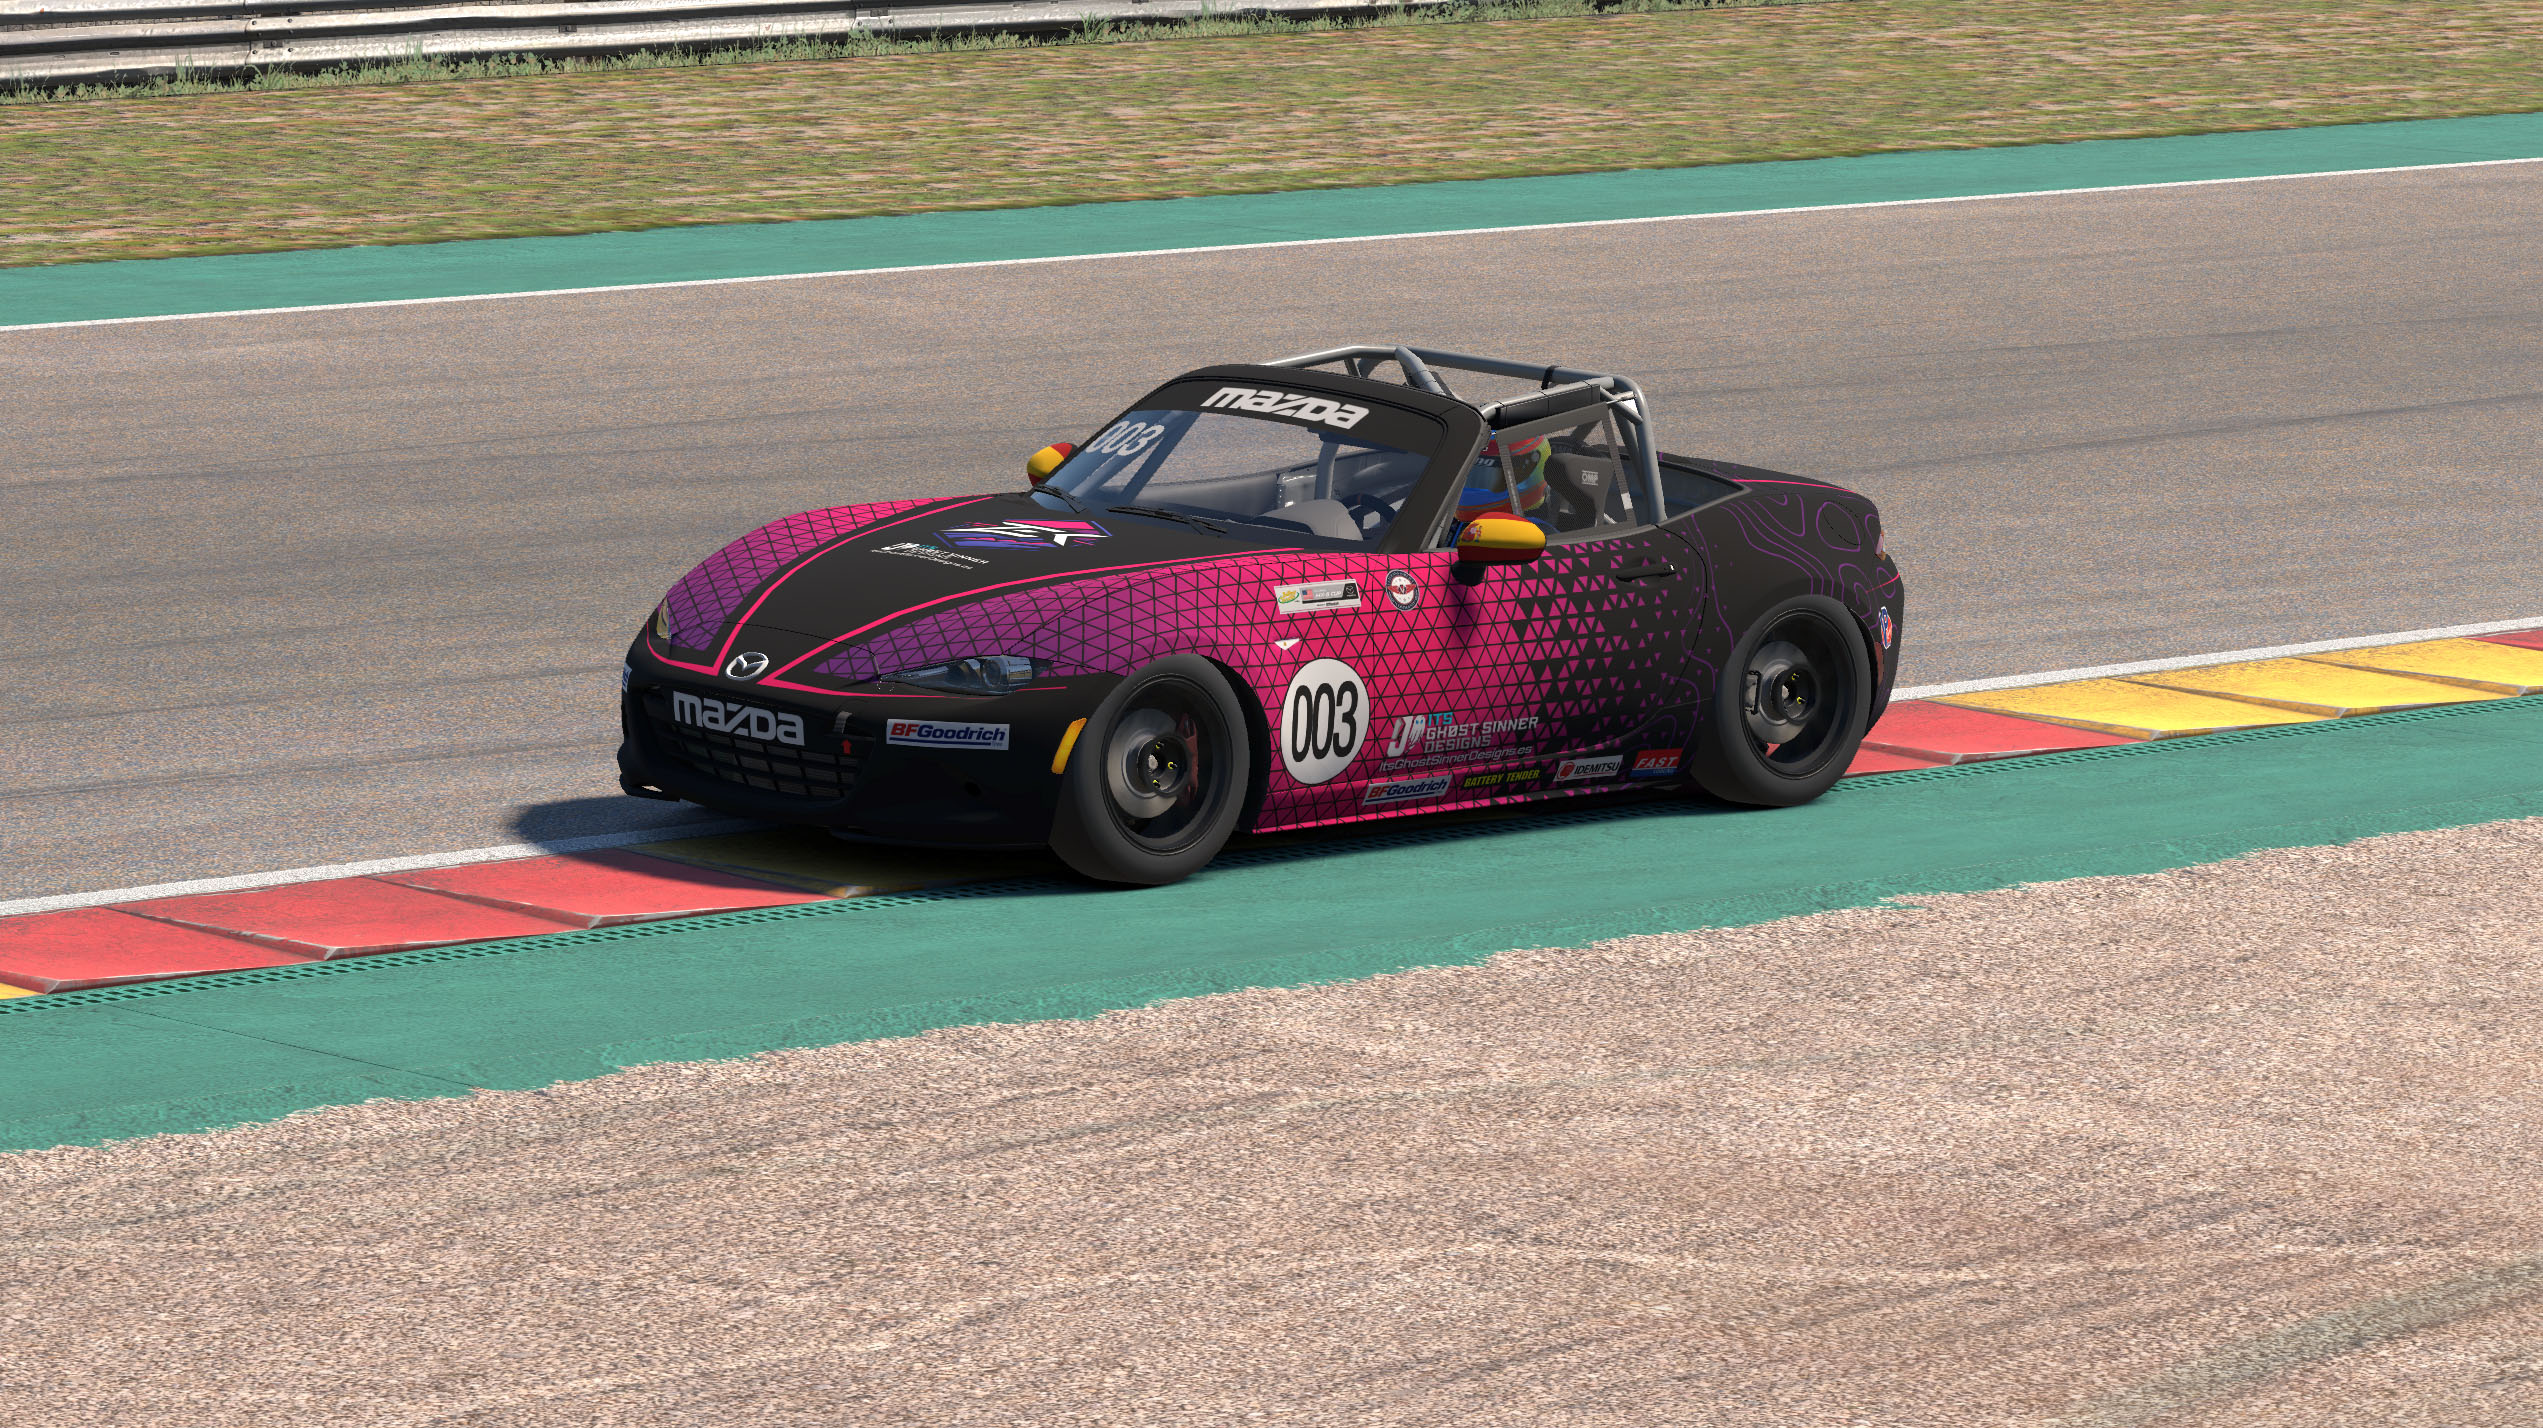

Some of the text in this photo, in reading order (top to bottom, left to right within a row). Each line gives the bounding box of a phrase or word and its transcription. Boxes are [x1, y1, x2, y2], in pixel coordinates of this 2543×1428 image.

[1085, 420, 1165, 456] 003
[1292, 681, 1358, 762] 003
[1428, 712, 1453, 726] ITS
[1482, 716, 1539, 734] SINNER
[890, 722, 1006, 742] BFGoodrich
[1424, 735, 1492, 753] DESIGNS
[1379, 745, 1533, 773] ItsGhostSinnerDesigns.es
[1574, 762, 1620, 775] IDEMITSU
[1636, 756, 1680, 769] FAST
[1464, 769, 1540, 788] BATTERY TENDER
[1368, 779, 1448, 798] BFGoodrich
